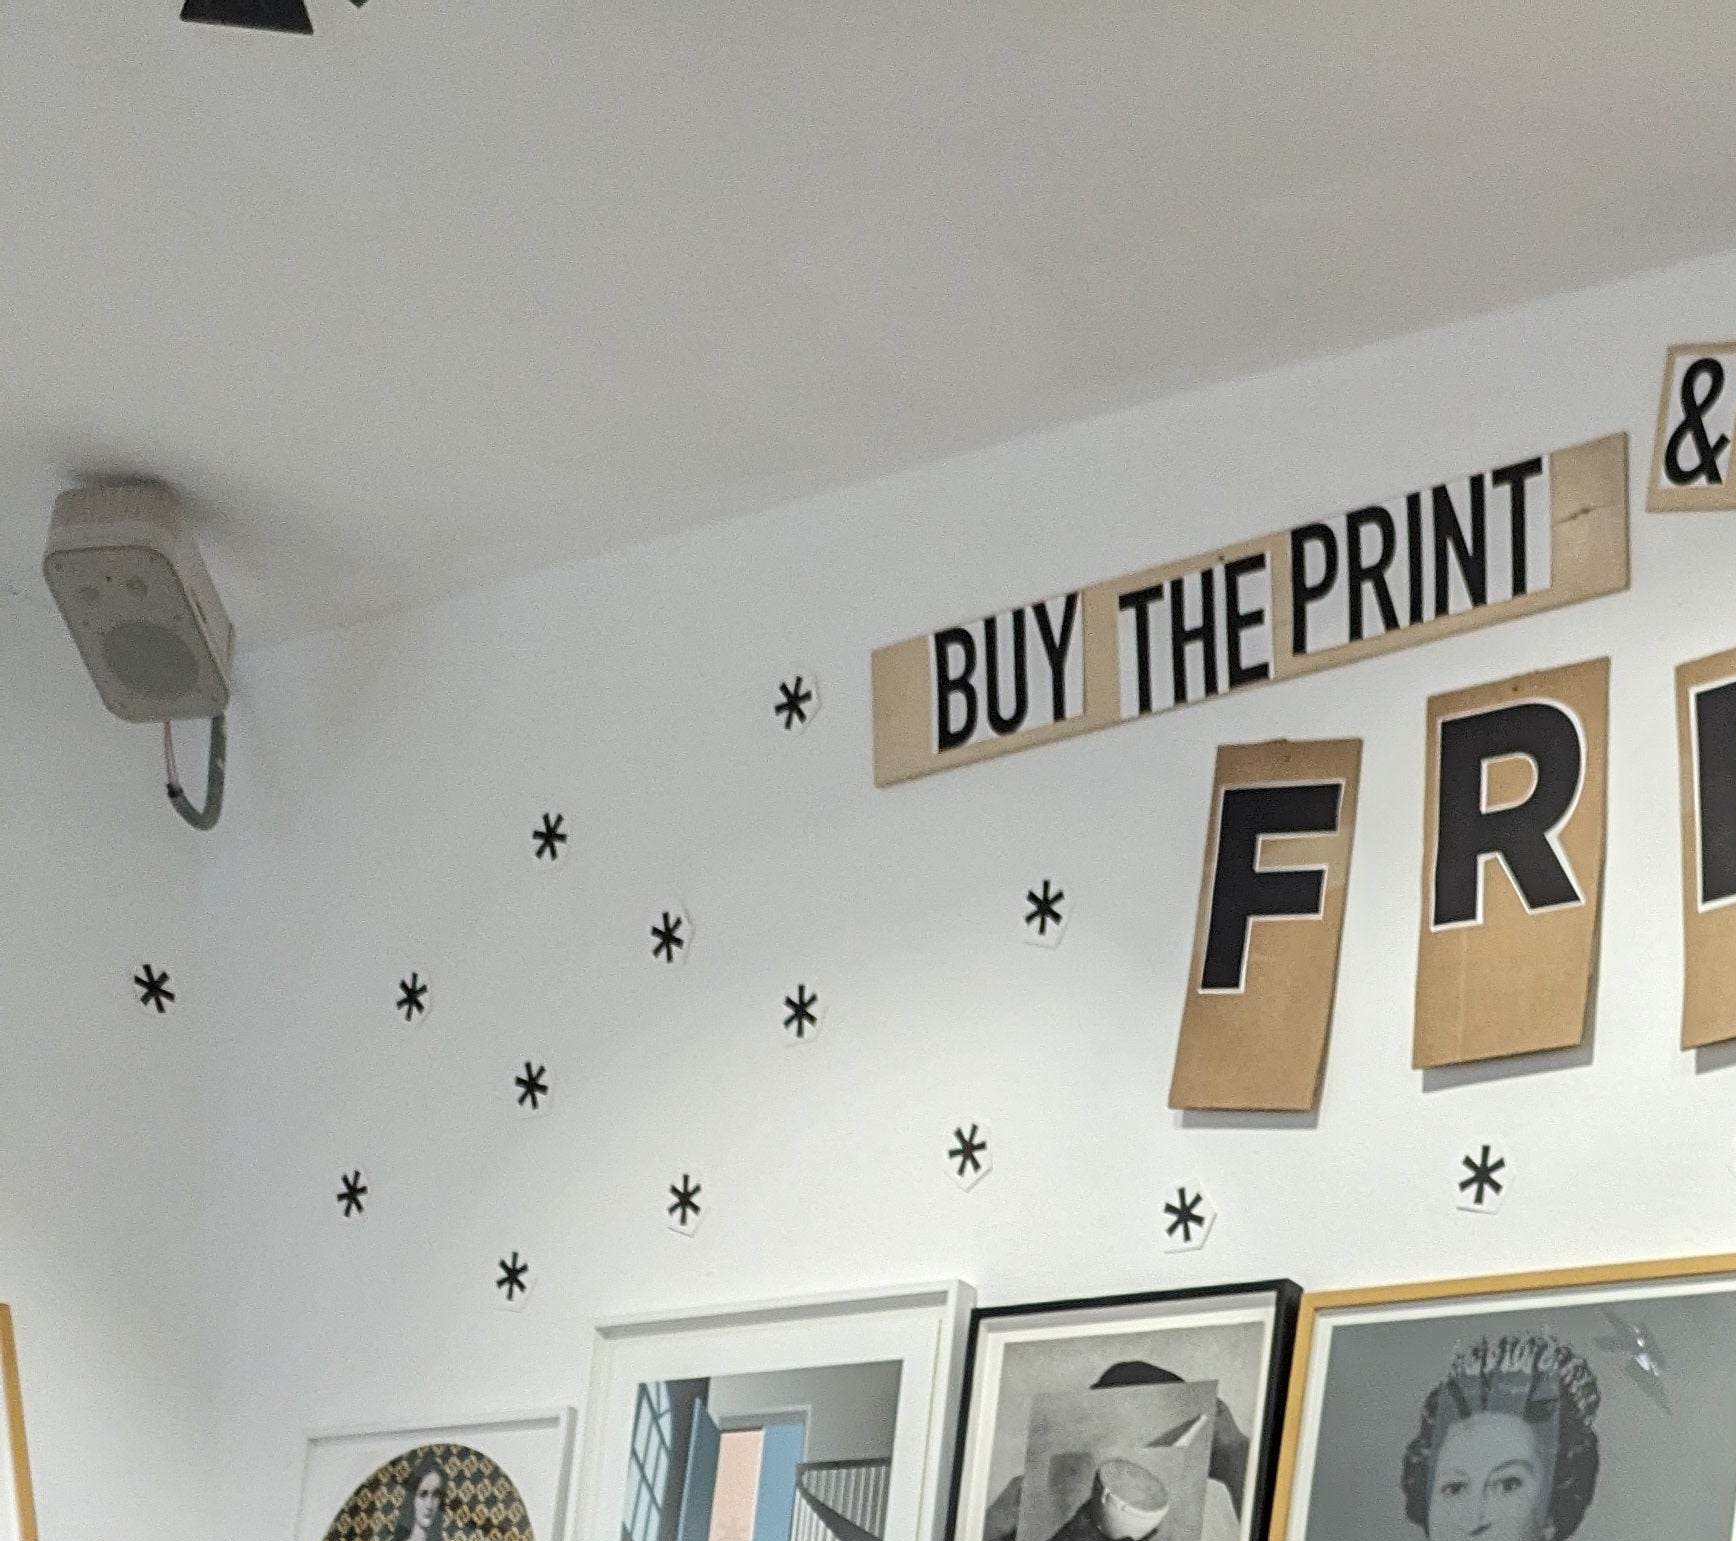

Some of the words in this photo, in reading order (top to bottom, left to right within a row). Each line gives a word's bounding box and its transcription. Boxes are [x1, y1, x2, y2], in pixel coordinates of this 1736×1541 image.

[1663, 355, 1732, 487] &
[932, 593, 1080, 754] BUY
[1118, 553, 1271, 716] THE
[1289, 457, 1543, 655] PRINT
